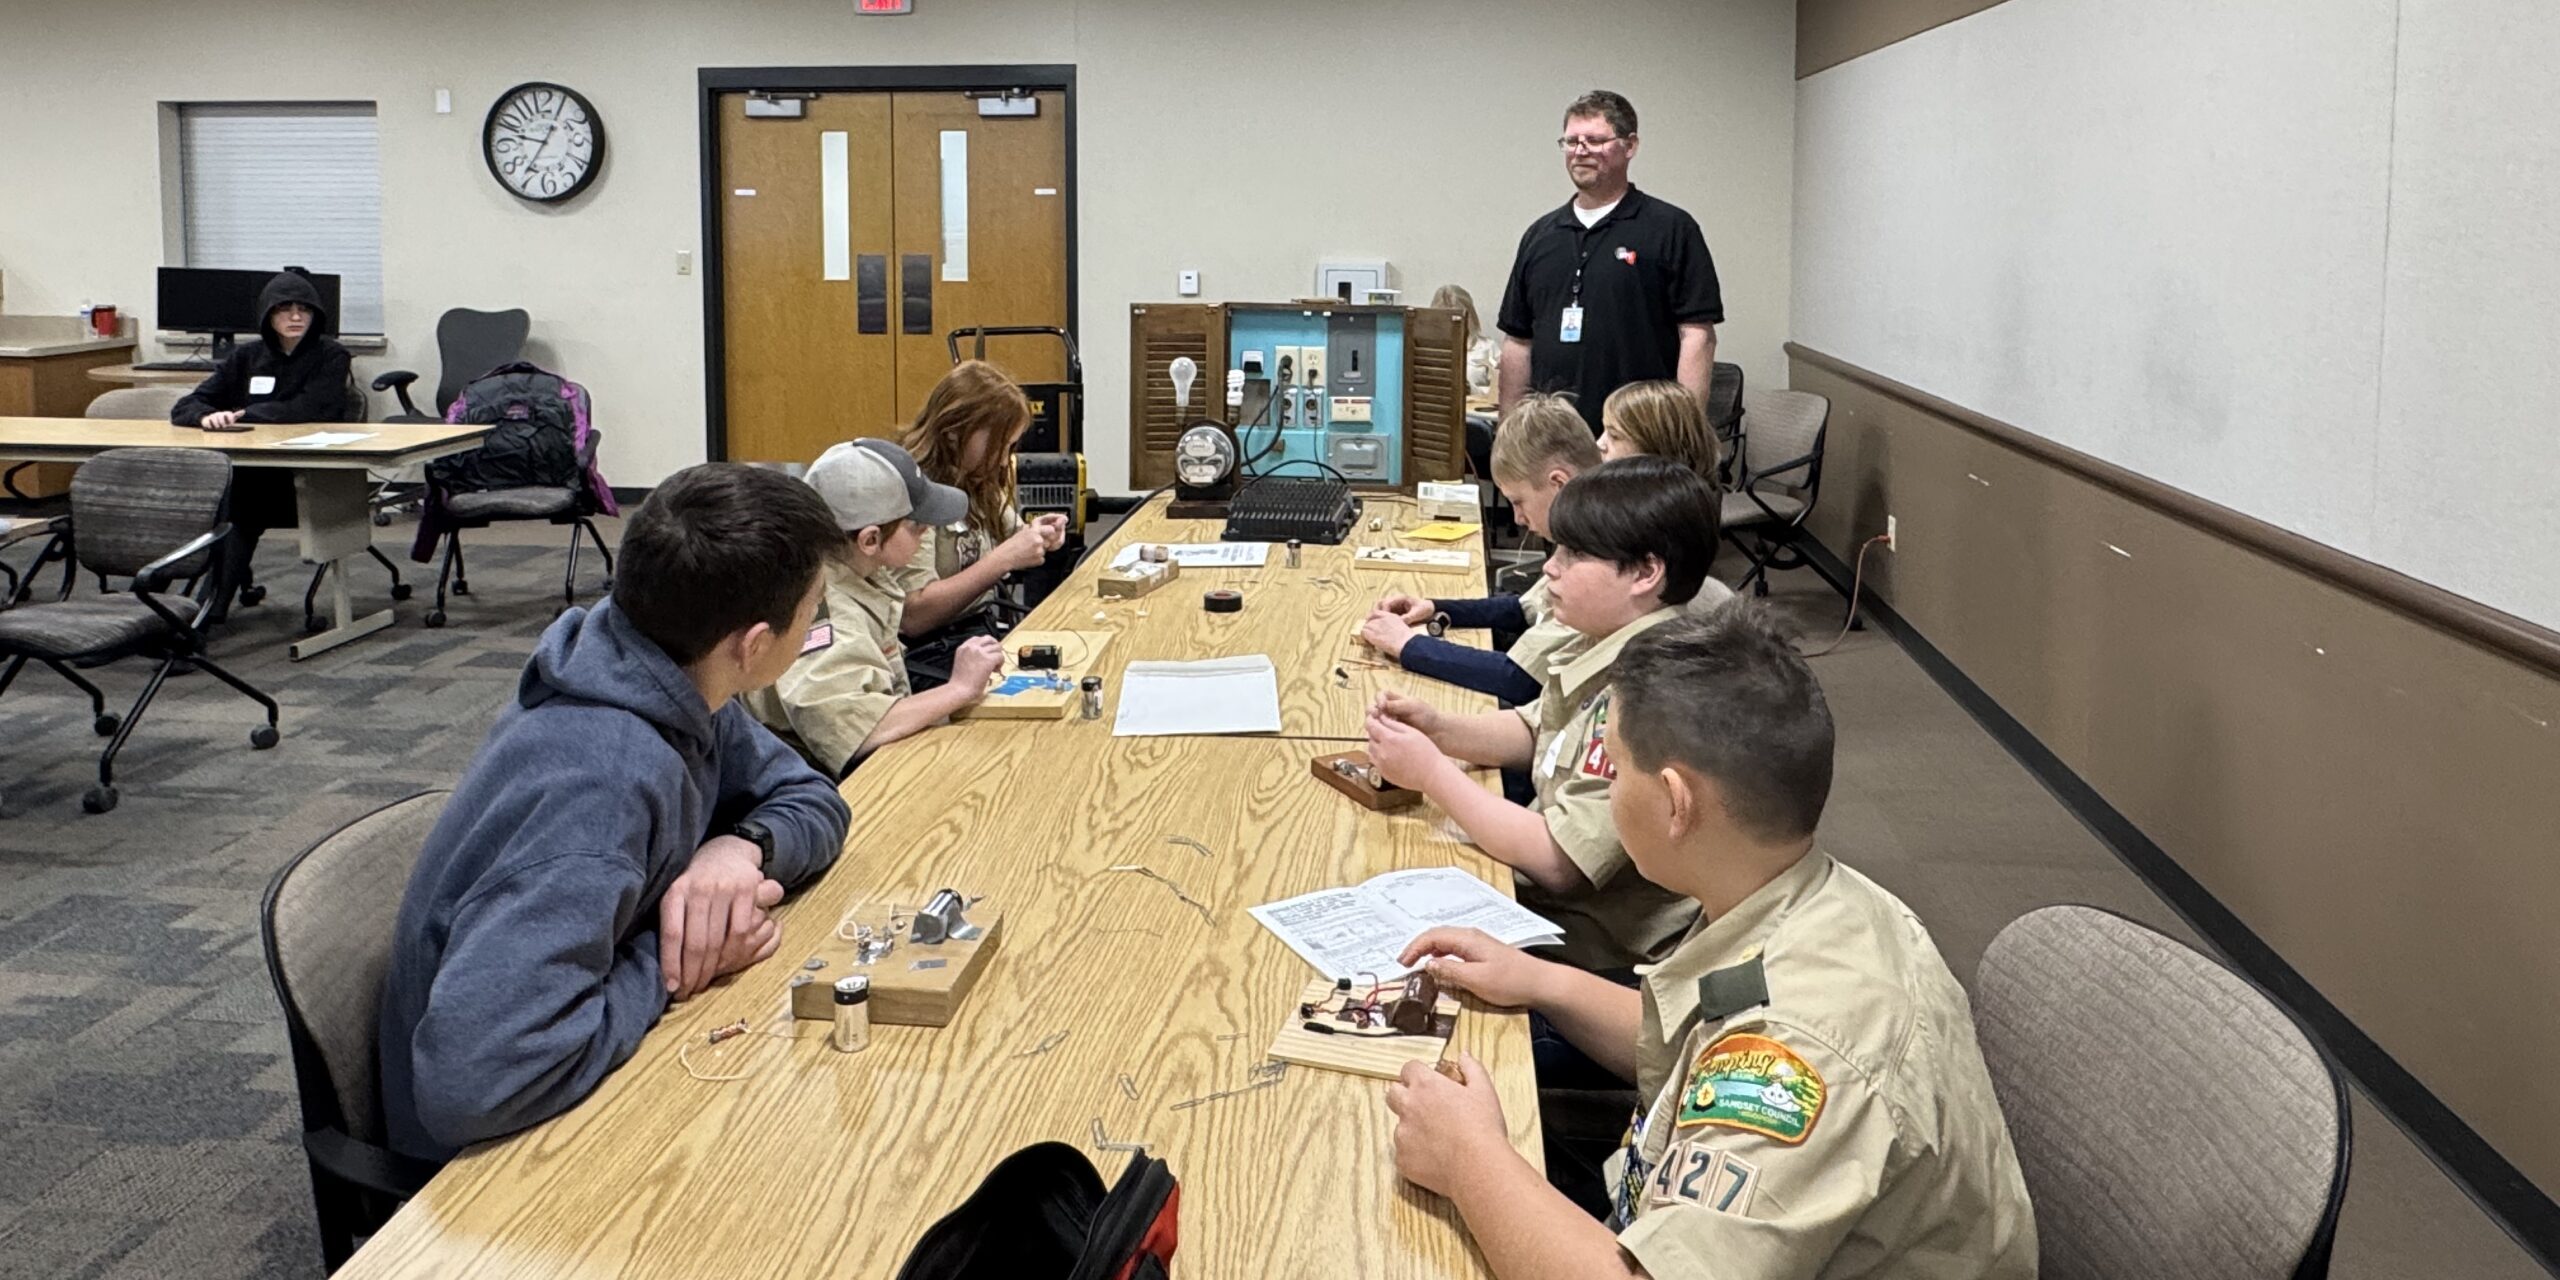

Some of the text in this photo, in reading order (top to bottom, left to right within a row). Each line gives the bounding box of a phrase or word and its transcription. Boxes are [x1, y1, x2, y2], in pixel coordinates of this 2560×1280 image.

[533, 90, 553, 114] 12
[554, 95, 567, 121] 1
[498, 113, 522, 133] 10
[565, 108, 588, 131] 2
[496, 137, 519, 154] 9
[573, 132, 592, 147] 3
[503, 156, 525, 175] 8
[566, 152, 589, 171] 4
[521, 166, 540, 192] 7
[541, 172, 557, 195] 6
[1656, 1149, 1749, 1211] 427
